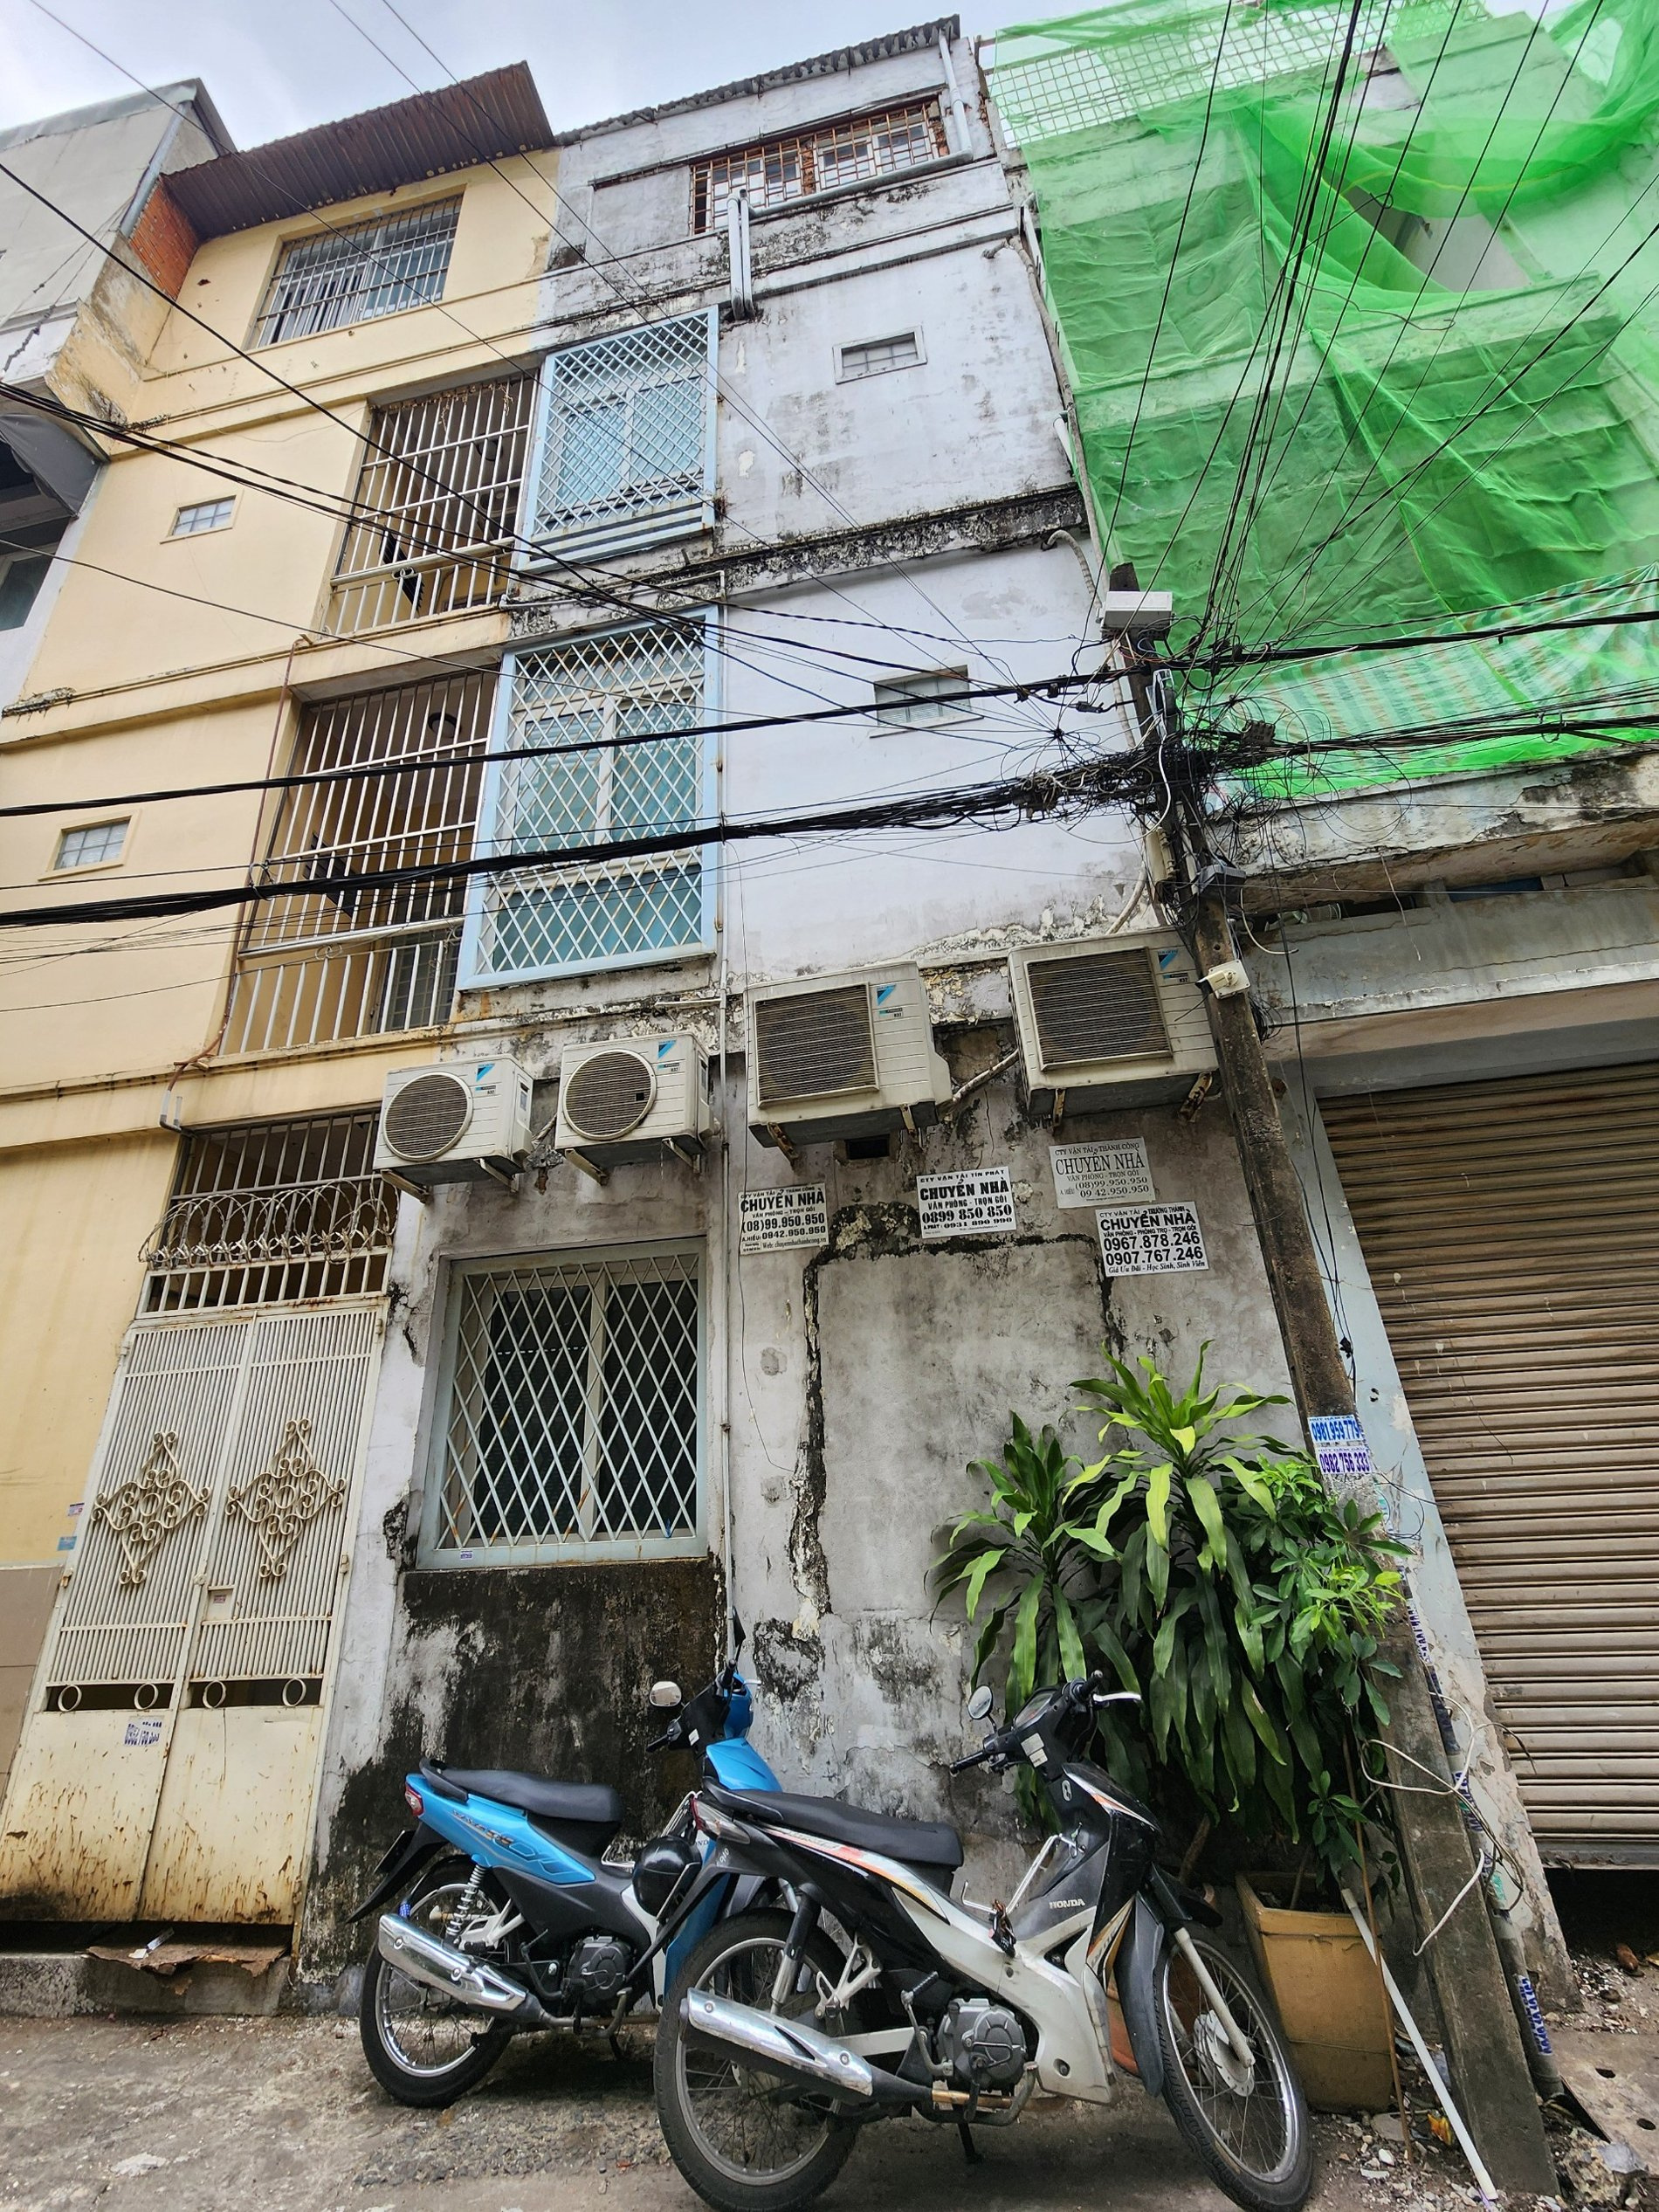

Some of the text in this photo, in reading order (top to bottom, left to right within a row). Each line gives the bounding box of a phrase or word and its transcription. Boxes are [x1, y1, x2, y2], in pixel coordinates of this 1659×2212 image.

[1056, 1147, 1145, 1175] CHUYỂN NHÀ
[920, 1177, 1009, 1201] CHUYỂN NHÀ
[1076, 1177, 1147, 1190] (08)99.950.950
[740, 1189, 825, 1212] CHUYỂN NHÀ
[742, 1213, 825, 1233] (08)99.950.950
[922, 1204, 1012, 1223] 0899 850 850
[1101, 1209, 1196, 1230] CHUYỂN NHÀ
[762, 1226, 825, 1239] 0942.950.950
[1104, 1231, 1200, 1251] 0967.878.246
[1106, 1246, 1203, 1265] 0907.767.246
[1319, 1452, 1370, 1473] 0982.756.333
[1050, 1899, 1085, 1909] HONDA
